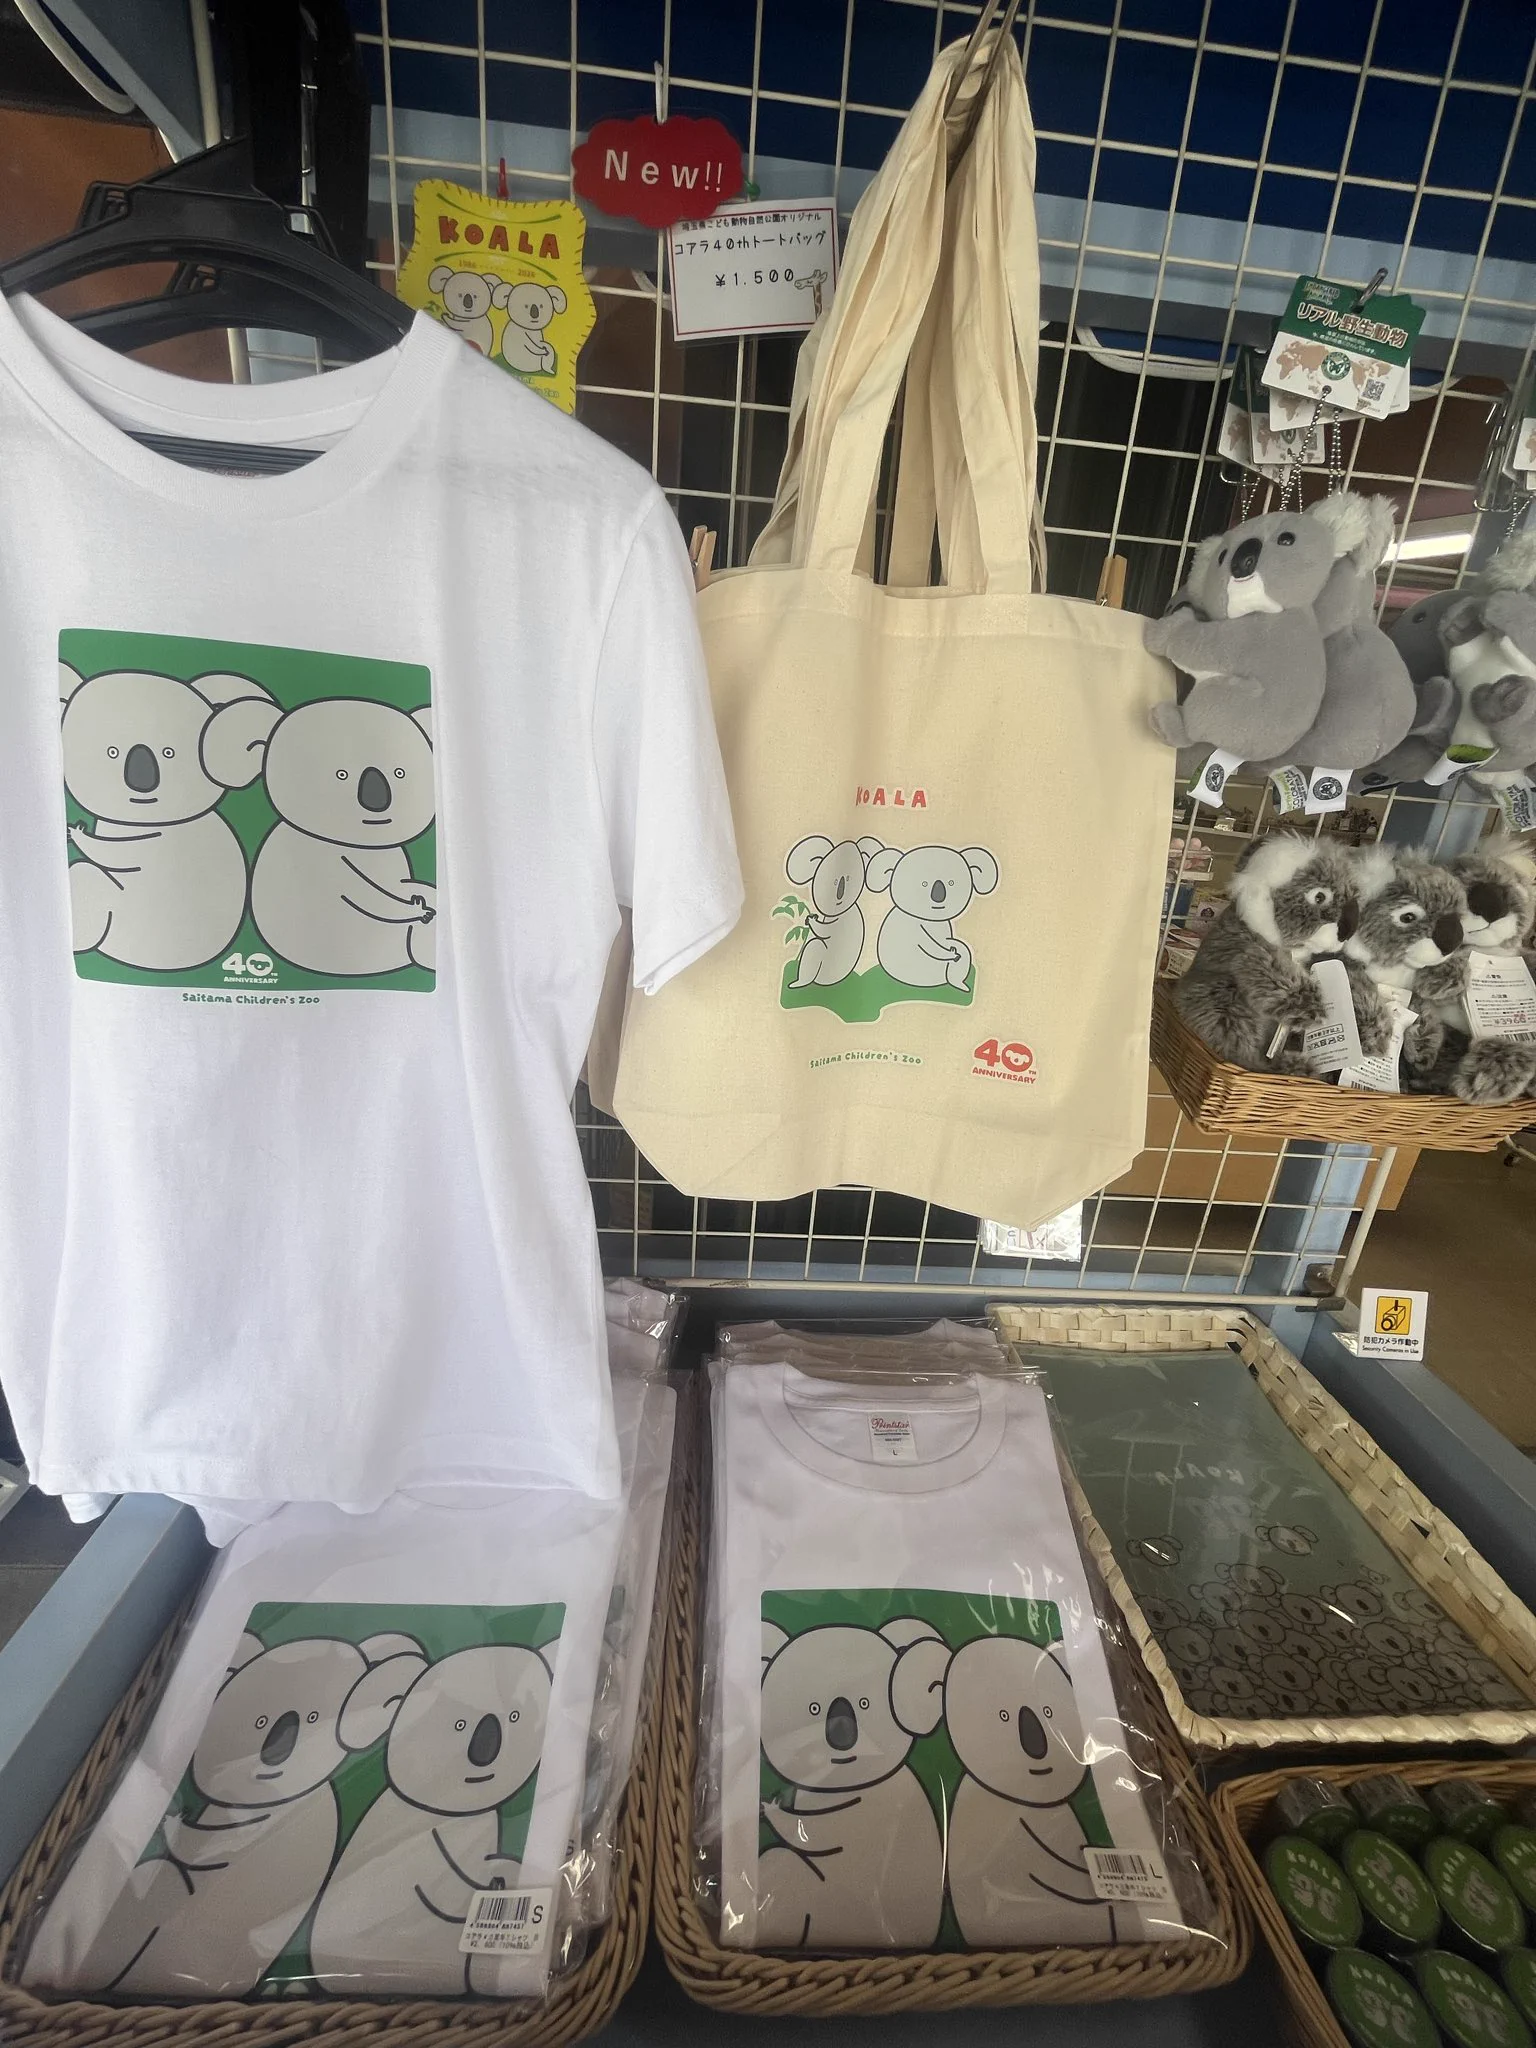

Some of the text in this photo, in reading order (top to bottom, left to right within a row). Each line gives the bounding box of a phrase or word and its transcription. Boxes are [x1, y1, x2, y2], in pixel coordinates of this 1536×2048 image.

[603, 148, 723, 193] New!!
[438, 215, 561, 260] KOALA
[1297, 301, 1409, 349] リアル野生動物
[855, 786, 928, 809] KOALA
[223, 976, 279, 984] ANNIVERSARY
[182, 992, 321, 1005] Saitama Children's Zoo
[809, 1052, 922, 1069] Saitama Children's Zoo
[974, 1038, 1034, 1073] 40
[971, 1066, 1037, 1085] ANNIVERSARY
[1149, 1863, 1163, 1879] L
[532, 1905, 544, 1924] S
